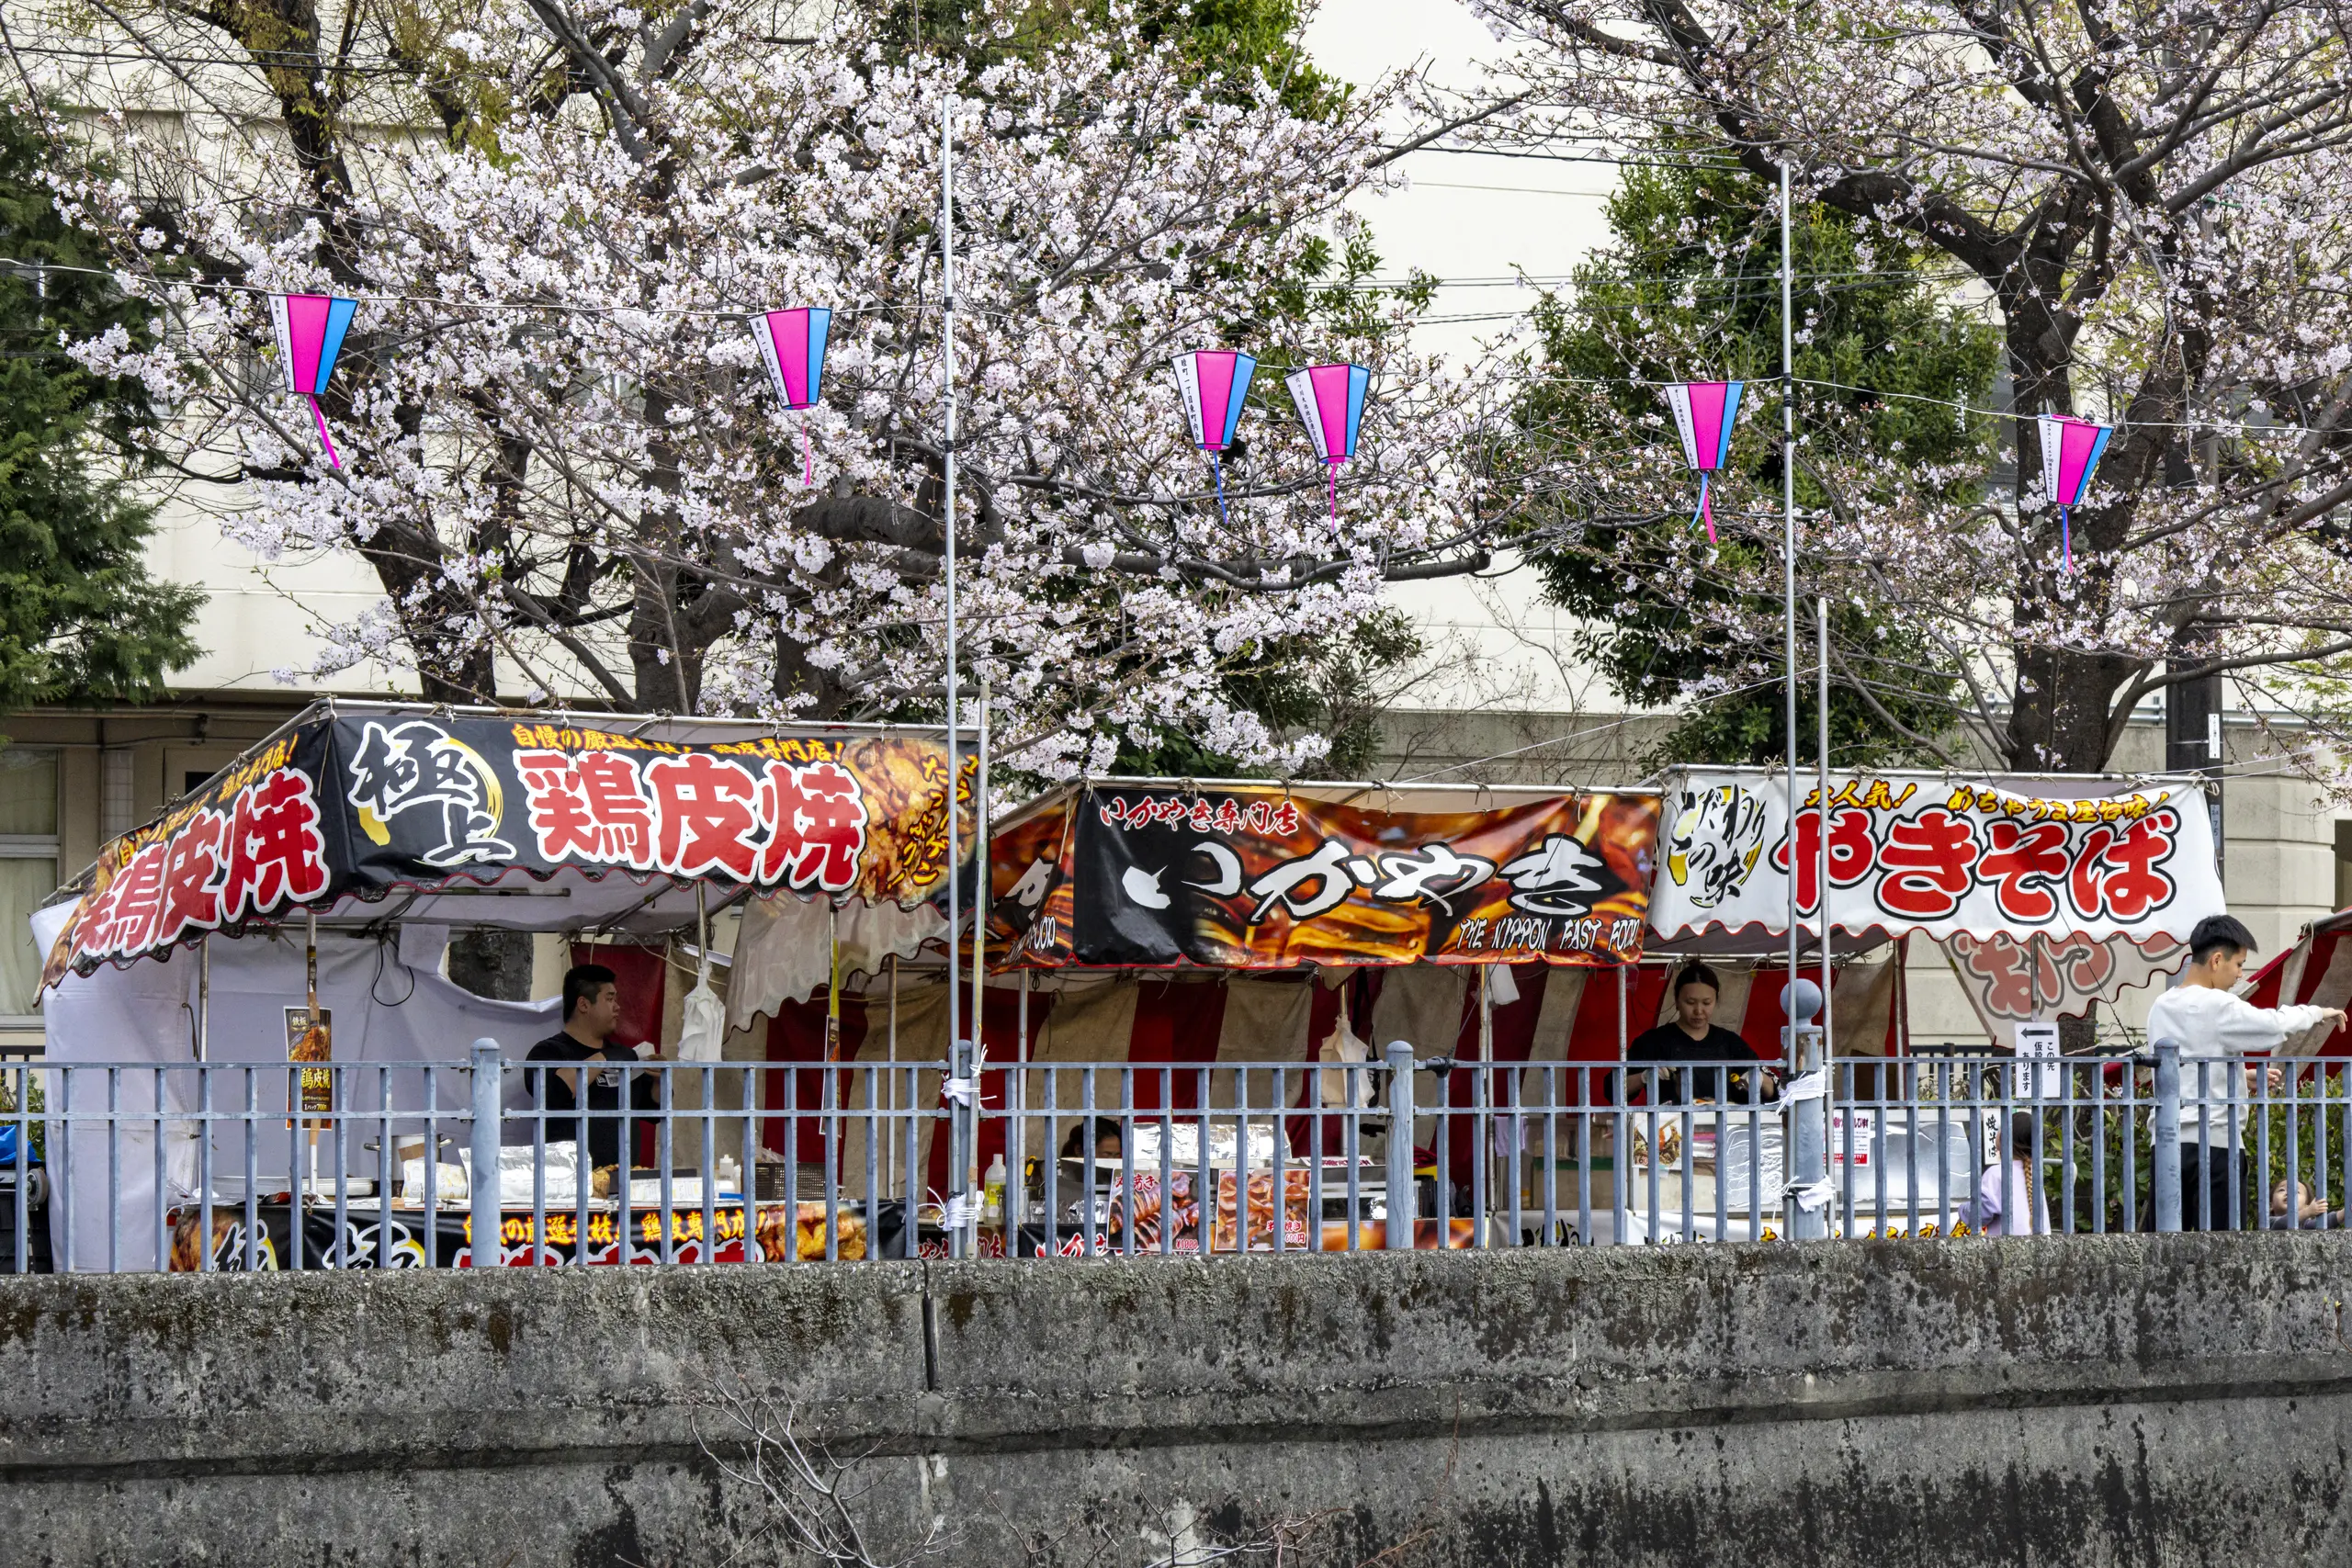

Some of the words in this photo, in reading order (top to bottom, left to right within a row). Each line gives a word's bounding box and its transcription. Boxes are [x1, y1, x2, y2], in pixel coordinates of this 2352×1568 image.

[66, 766, 332, 969] 鶏皮焼
[513, 748, 869, 891] 鶏皮焼
[1100, 795, 1299, 835] いかやき専門店
[1769, 805, 2182, 924] やきそば
[1456, 918, 1488, 950] THE
[1490, 917, 1552, 951] NIPPON
[1559, 919, 1602, 950] FAST
[1608, 919, 1641, 952] FOOD
